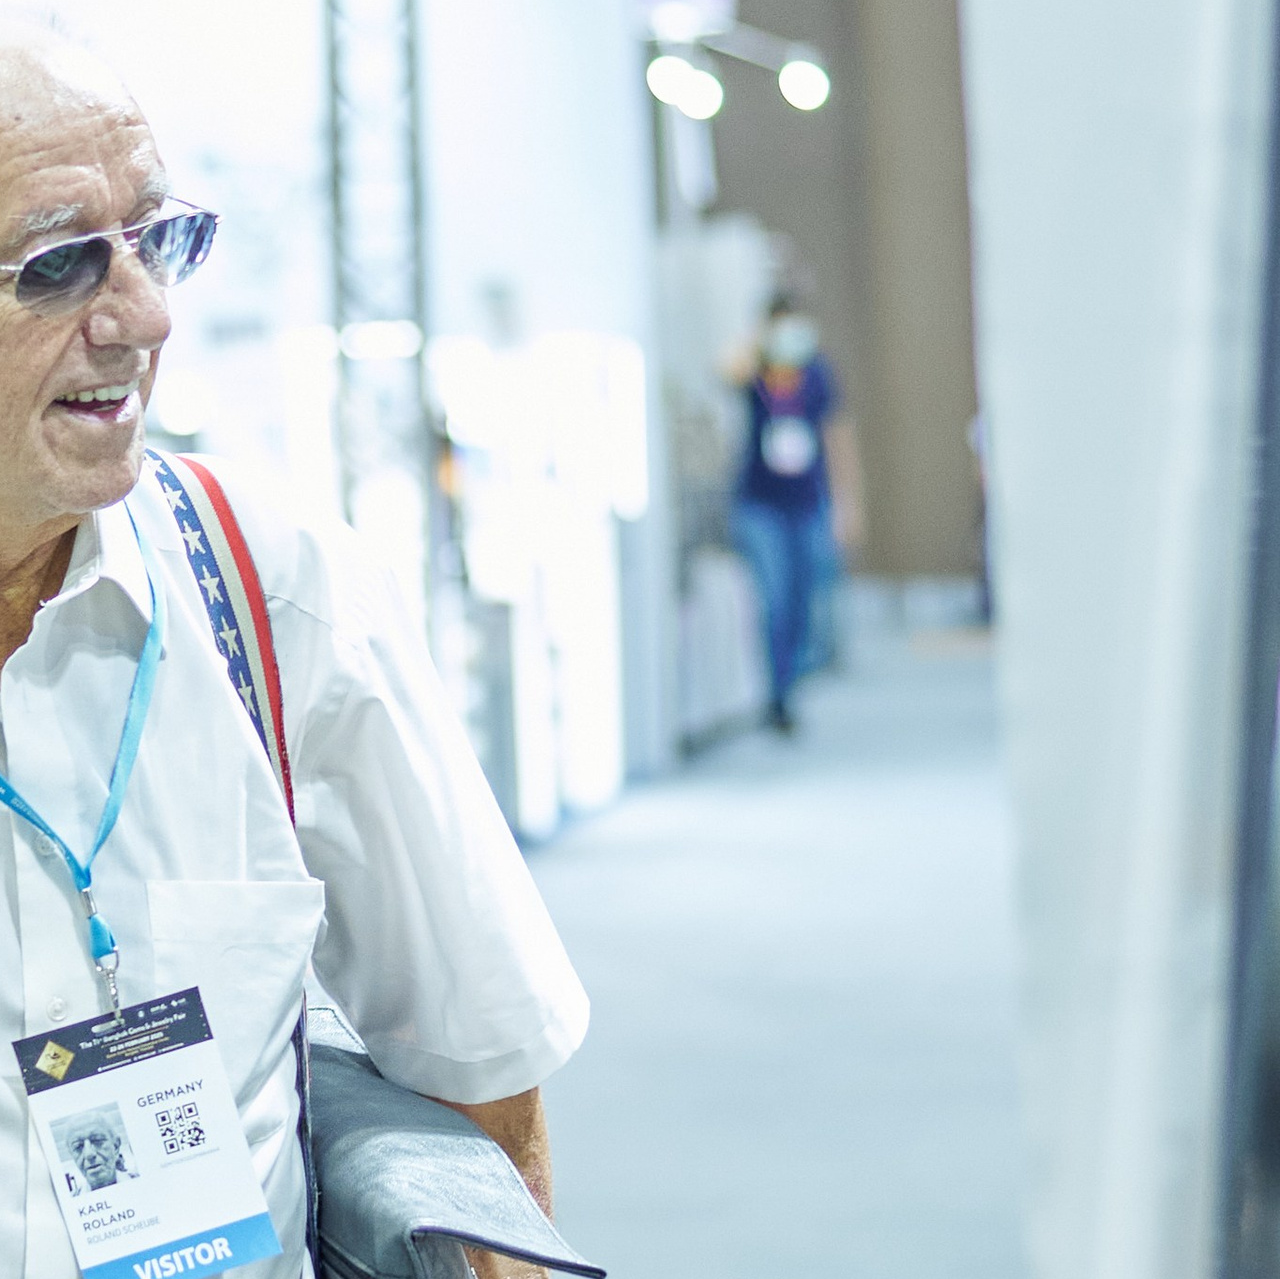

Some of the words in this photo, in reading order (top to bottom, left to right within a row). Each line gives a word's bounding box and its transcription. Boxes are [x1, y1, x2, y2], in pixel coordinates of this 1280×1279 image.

[137, 1079, 203, 1108] GERMANY
[78, 1200, 112, 1218] KARL
[83, 1209, 136, 1232] ROLAND
[86, 1226, 122, 1245] ROLAND
